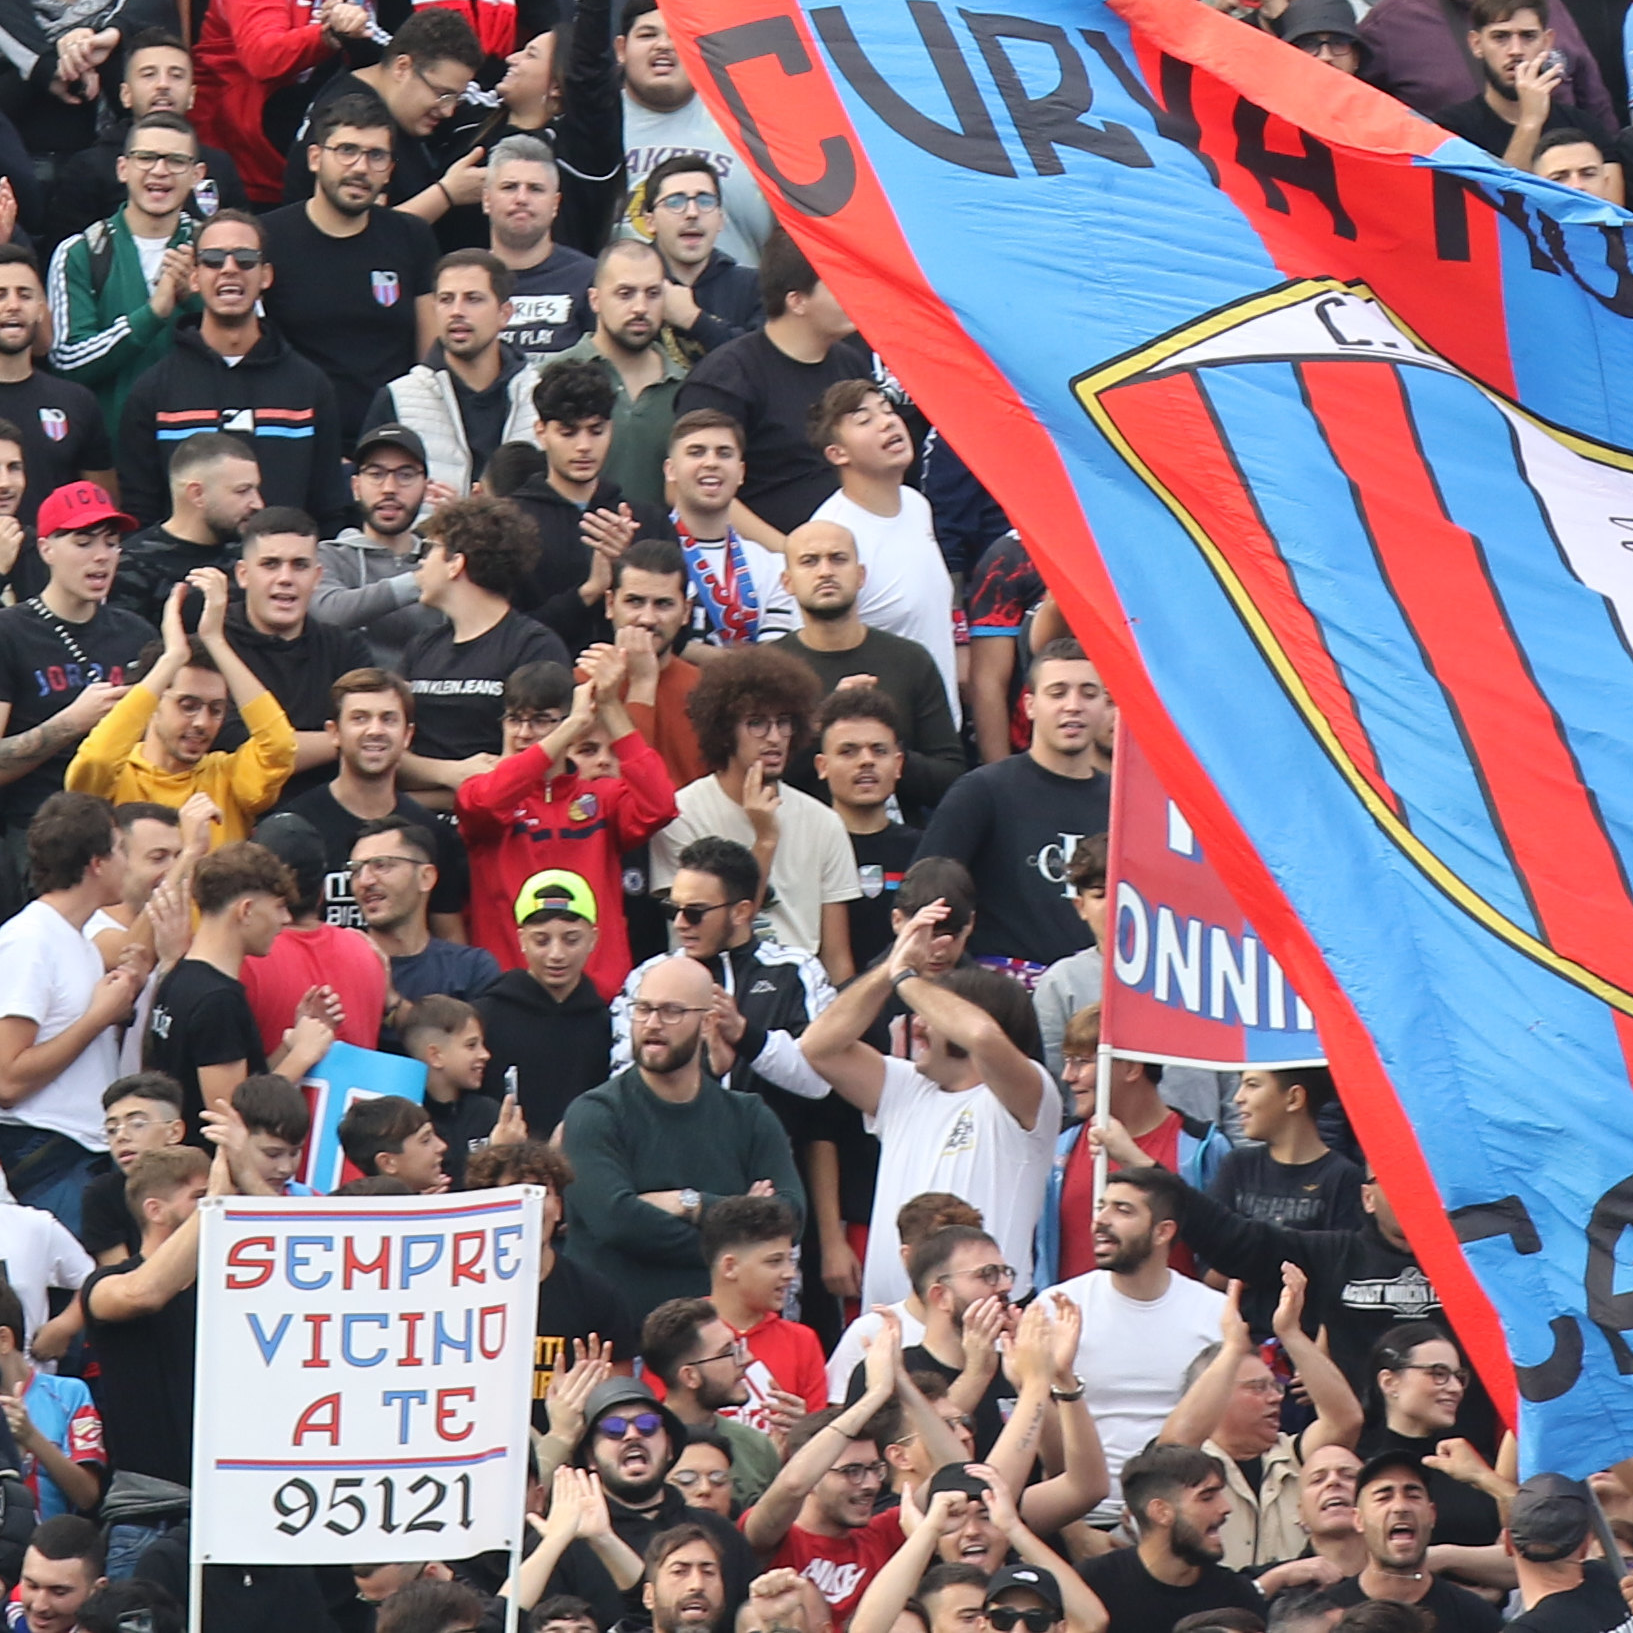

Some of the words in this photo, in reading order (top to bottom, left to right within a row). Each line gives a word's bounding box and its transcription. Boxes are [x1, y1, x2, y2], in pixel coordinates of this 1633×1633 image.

[225, 1223, 525, 1293] SEMPRE
[246, 1303, 508, 1368] VICINO
[293, 1391, 344, 1449] A
[382, 1386, 478, 1446] TE
[272, 1473, 476, 1539] 95121
